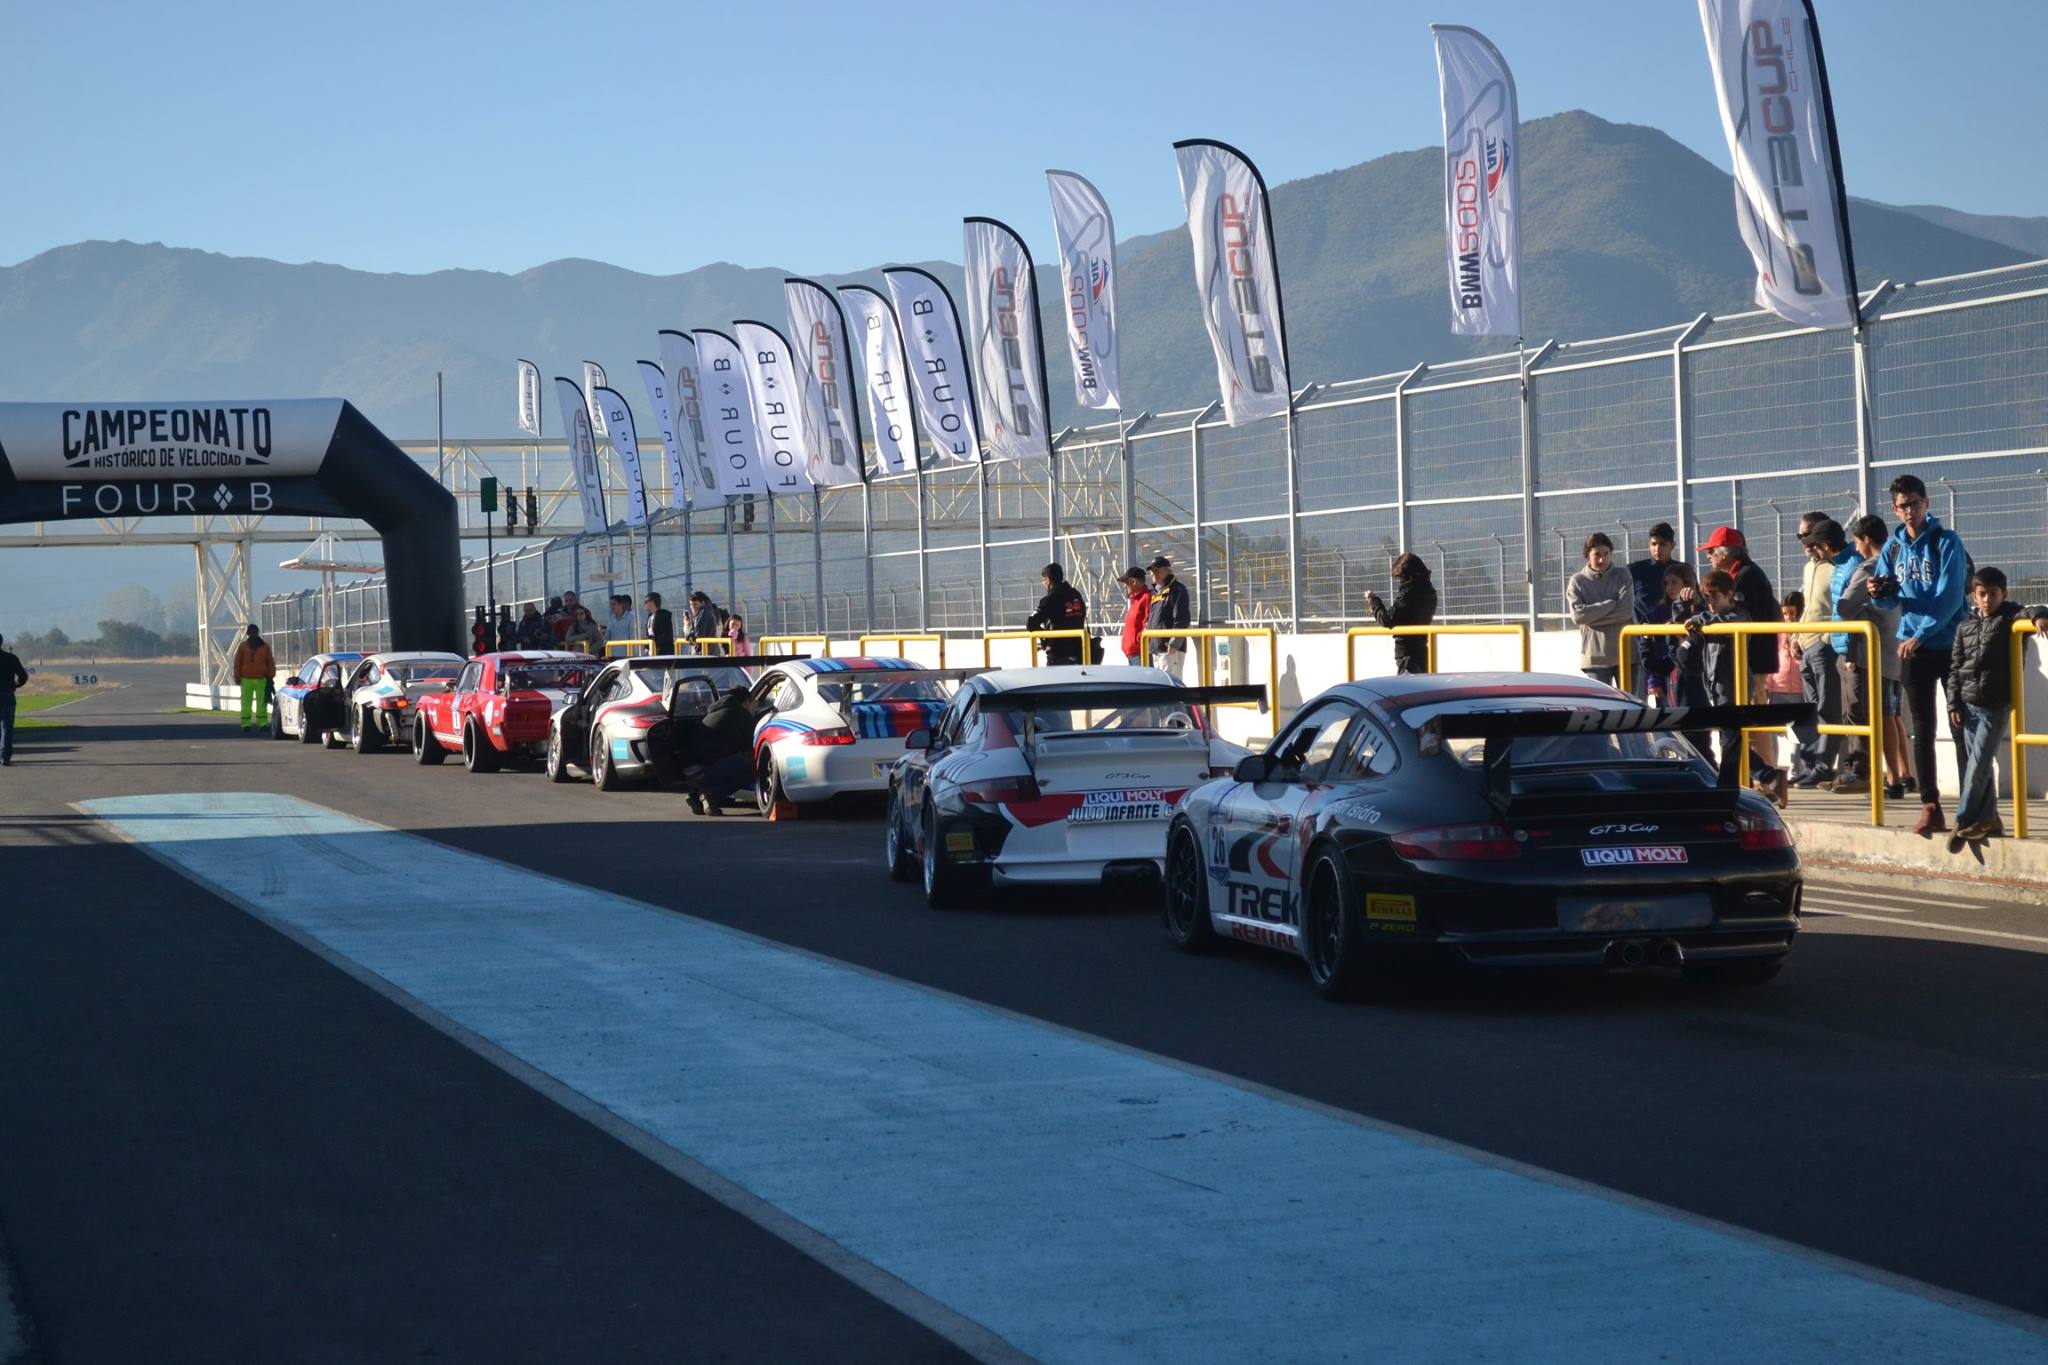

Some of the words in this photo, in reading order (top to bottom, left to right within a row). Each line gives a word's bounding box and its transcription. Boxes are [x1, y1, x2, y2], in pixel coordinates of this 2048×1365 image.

[62, 408, 272, 461] CAMPEONATO
[94, 447, 156, 468] HISTÓRICO
[160, 447, 175, 467] DE
[178, 448, 241, 467] VELOCIDAD
[62, 483, 197, 515] FOUR
[250, 482, 273, 512] B
[1895, 555, 1935, 585] GAP
[73, 674, 97, 685] 150
[1565, 706, 1690, 732] RUIZ
[1088, 792, 1124, 803] LIQUI
[1127, 790, 1162, 801] MOLY
[1212, 826, 1226, 866] 26
[1585, 850, 1634, 864] LIQUI
[1636, 848, 1683, 862] MOLY
[1225, 881, 1299, 927] TREK
